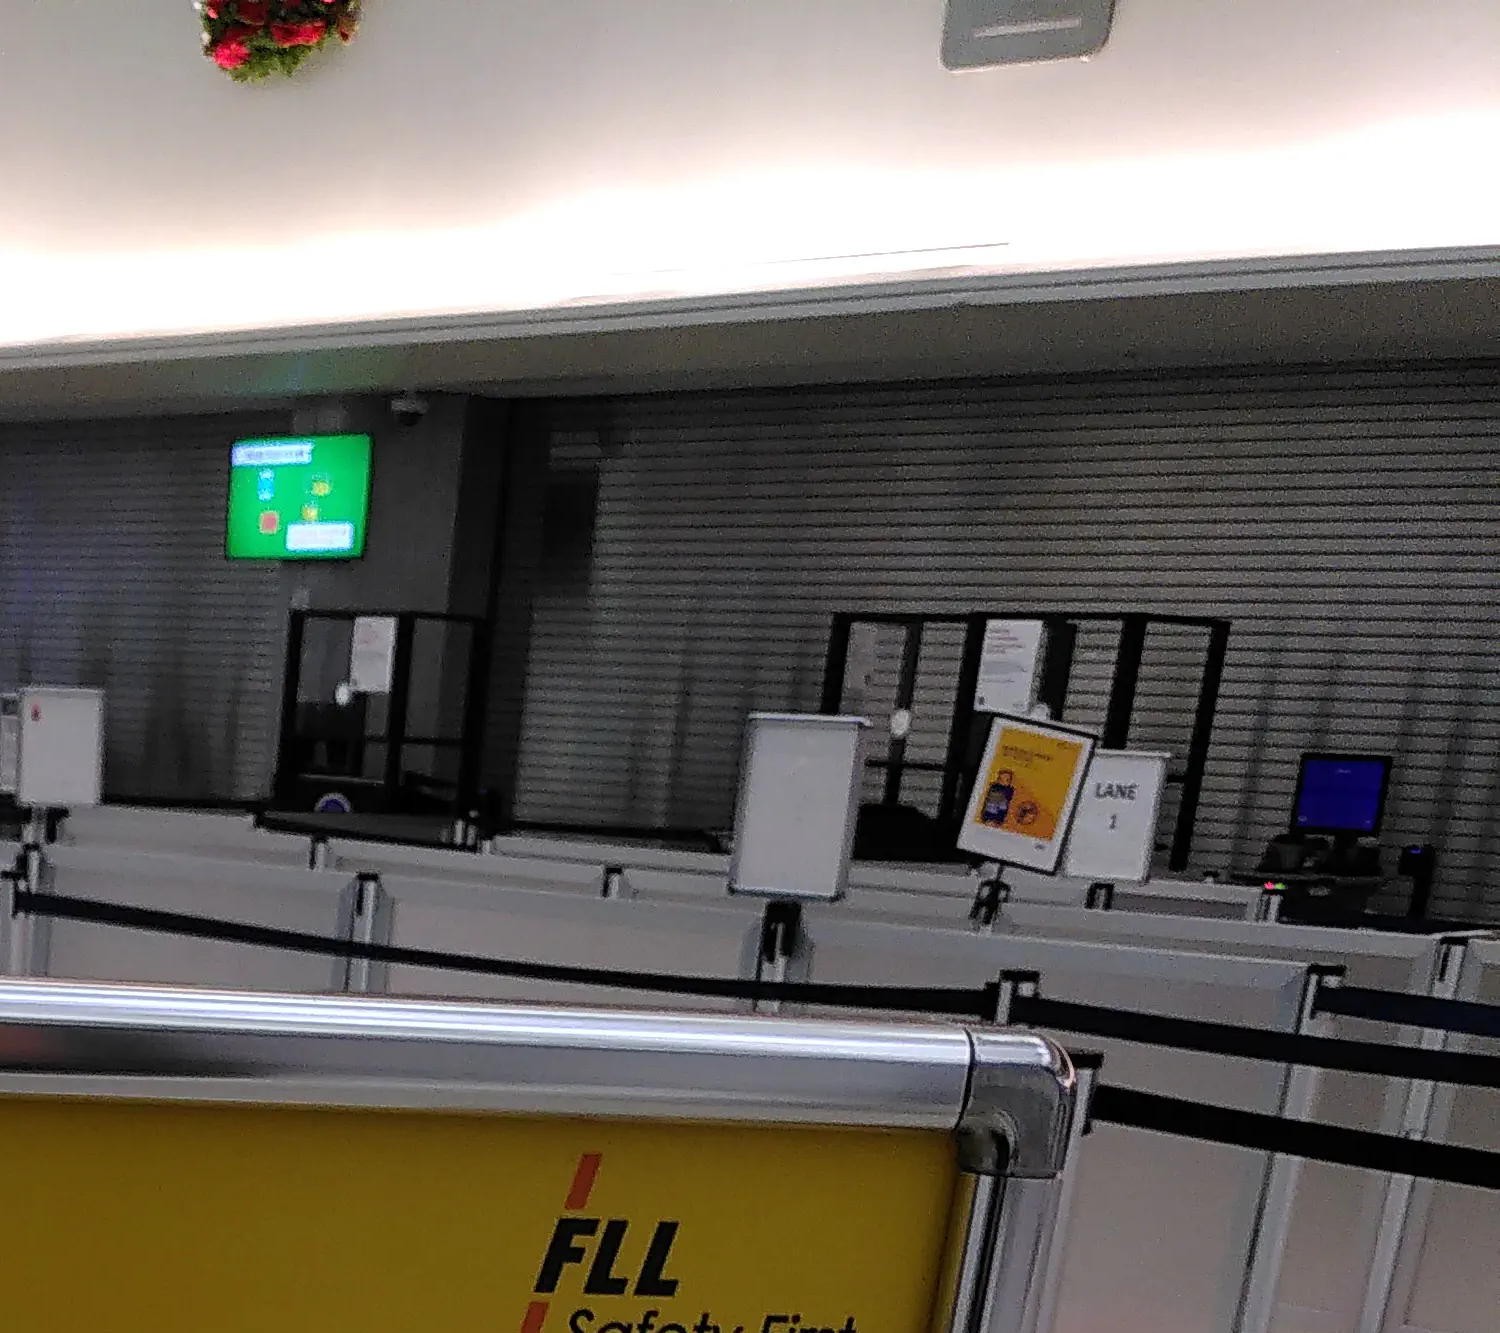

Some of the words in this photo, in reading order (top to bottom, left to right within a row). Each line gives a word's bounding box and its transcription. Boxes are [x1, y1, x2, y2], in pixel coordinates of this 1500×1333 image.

[1095, 782, 1139, 801] LANE
[1108, 813, 1118, 830] 1
[533, 1216, 680, 1297] FLL
